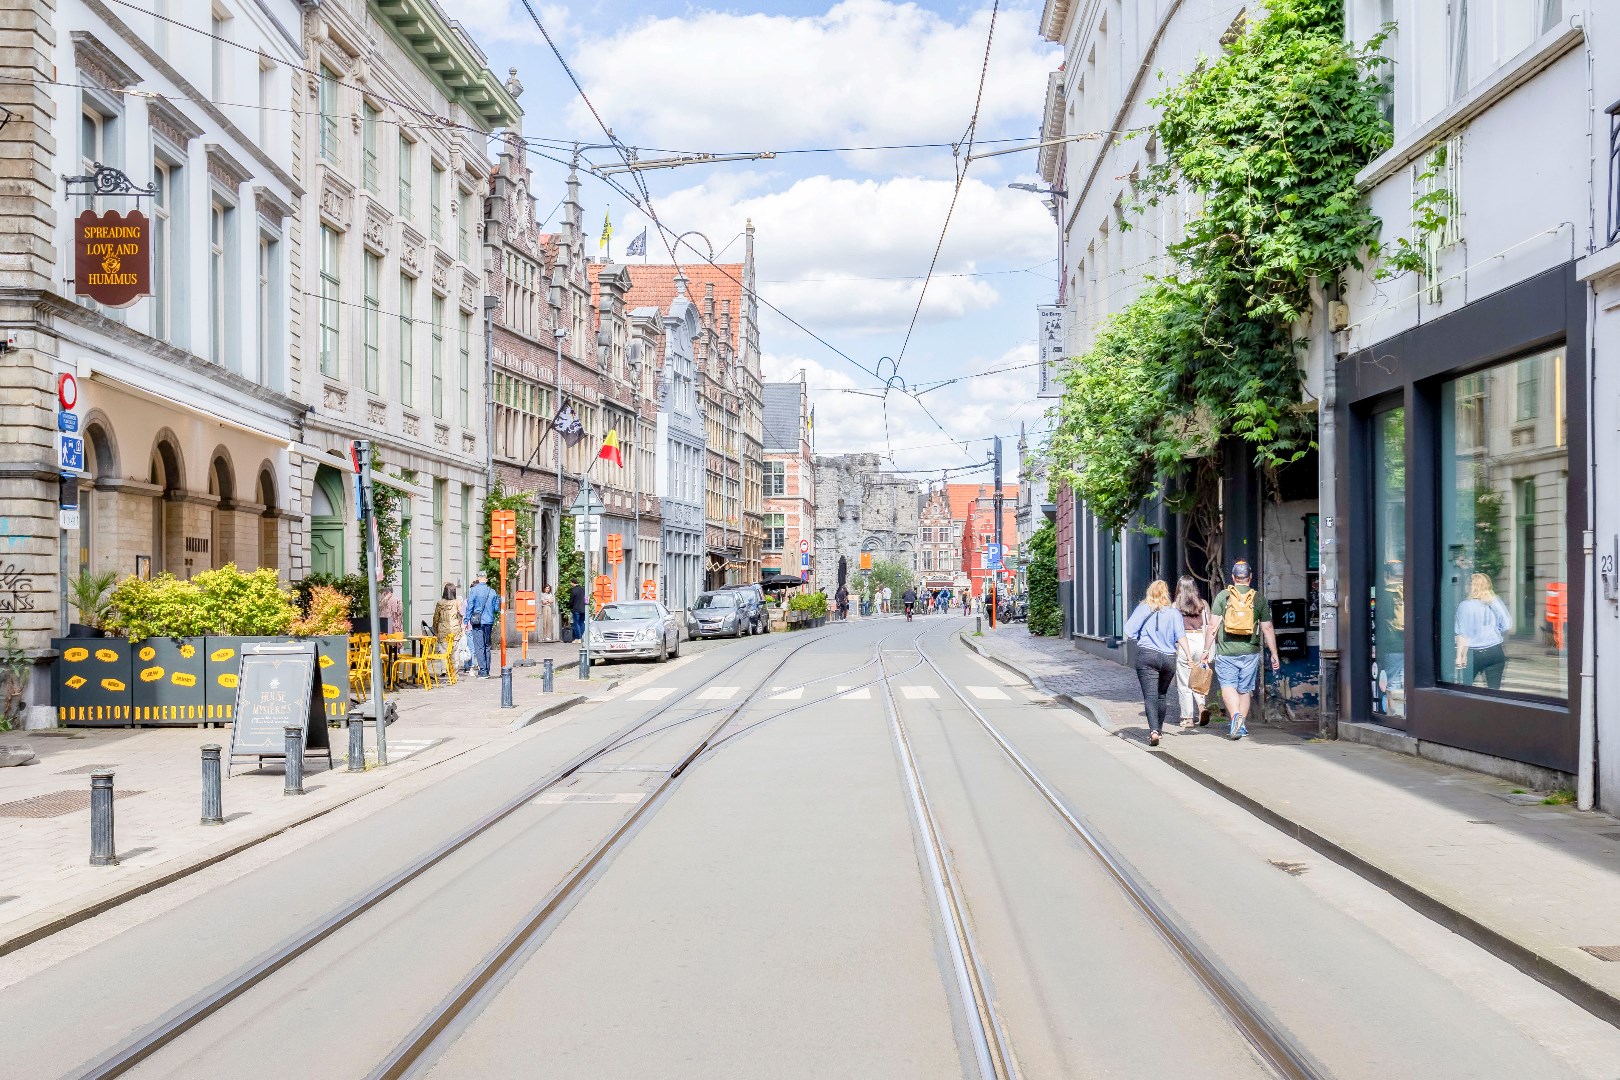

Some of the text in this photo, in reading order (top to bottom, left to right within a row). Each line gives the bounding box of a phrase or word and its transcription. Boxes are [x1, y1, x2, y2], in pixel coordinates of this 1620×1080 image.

[84, 226, 141, 238] SPREADING
[86, 243, 139, 255] LOVE AND
[88, 273, 138, 284] HUMMUS
[1601, 554, 1613, 573] 23
[1282, 611, 1296, 624] 19
[60, 705, 130, 720] BOKERTOV
[134, 705, 204, 720] BOKERTOV
[207, 704, 233, 719] BOK
